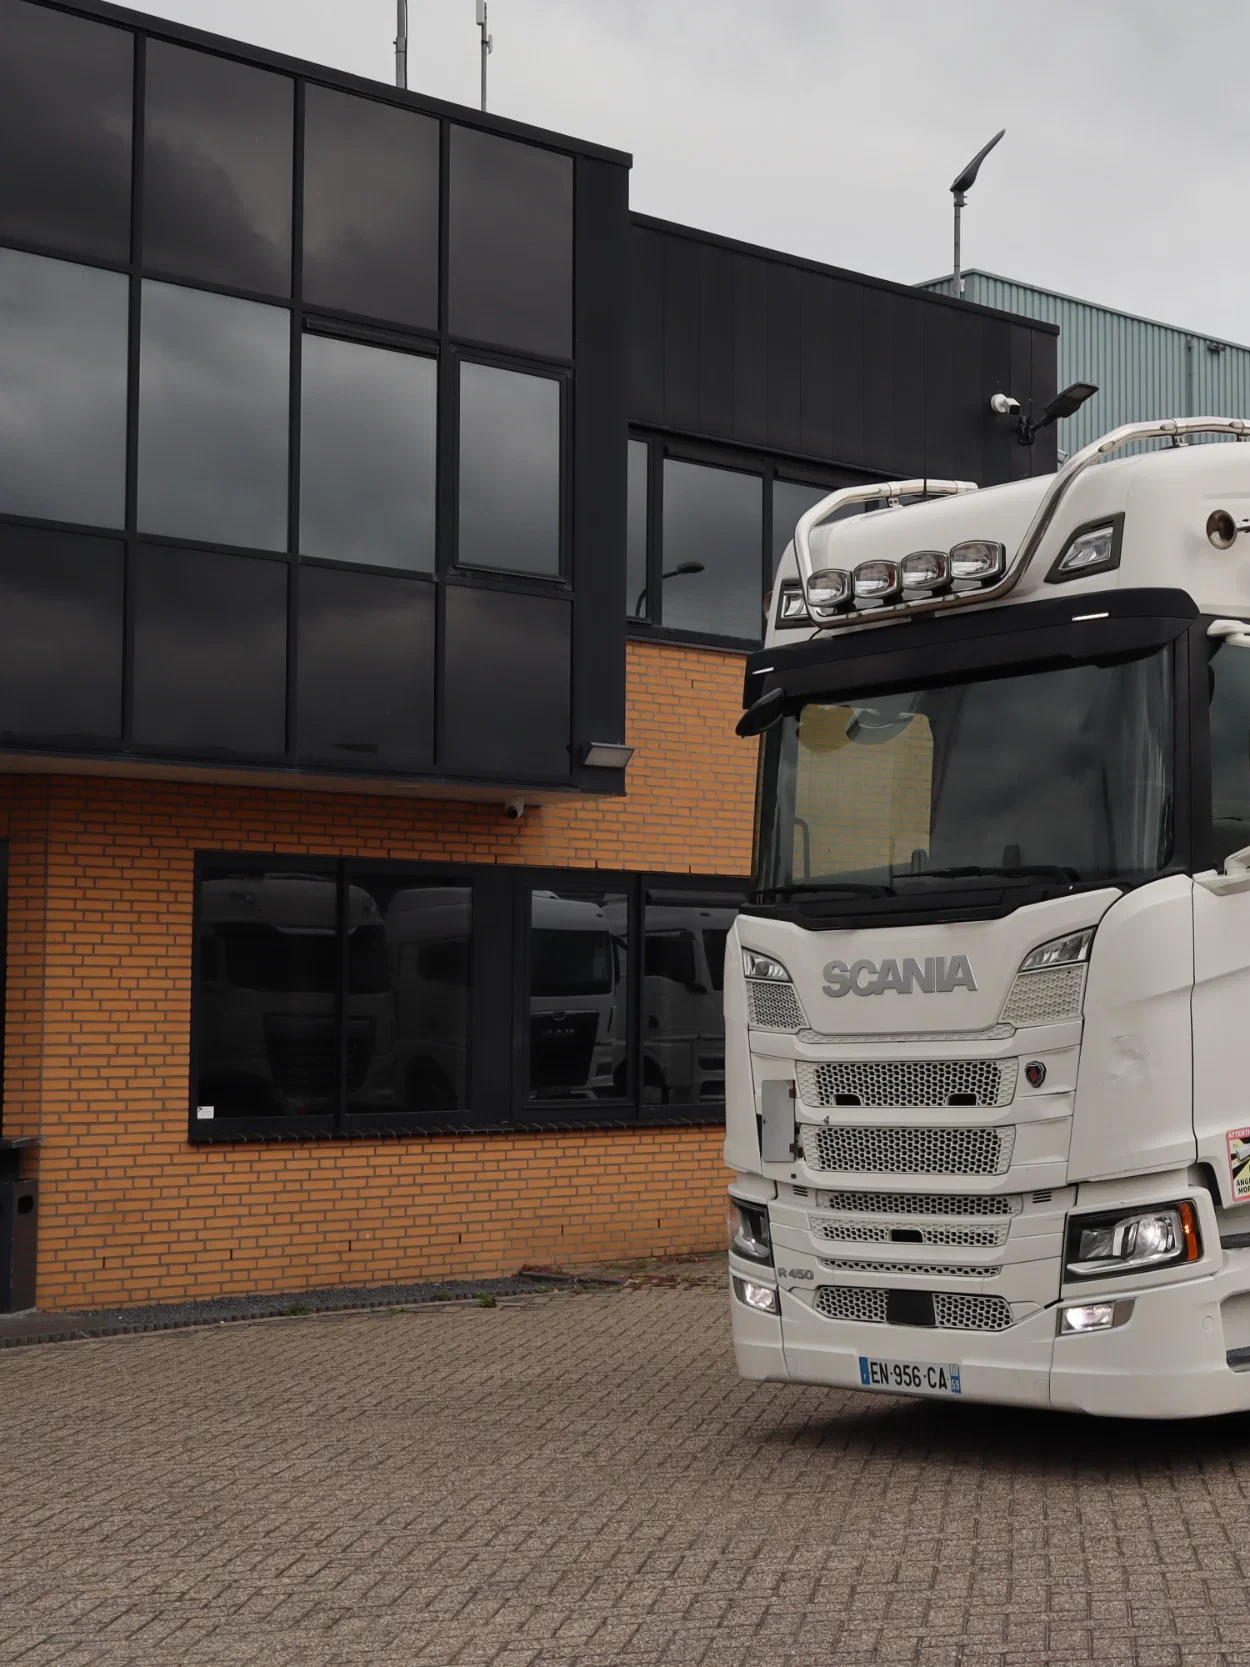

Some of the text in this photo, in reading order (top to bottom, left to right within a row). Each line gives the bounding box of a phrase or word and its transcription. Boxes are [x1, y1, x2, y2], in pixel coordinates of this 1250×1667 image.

[822, 954, 979, 998] SCANIA
[777, 1267, 815, 1280] R 450
[951, 1379, 960, 1391] 59
